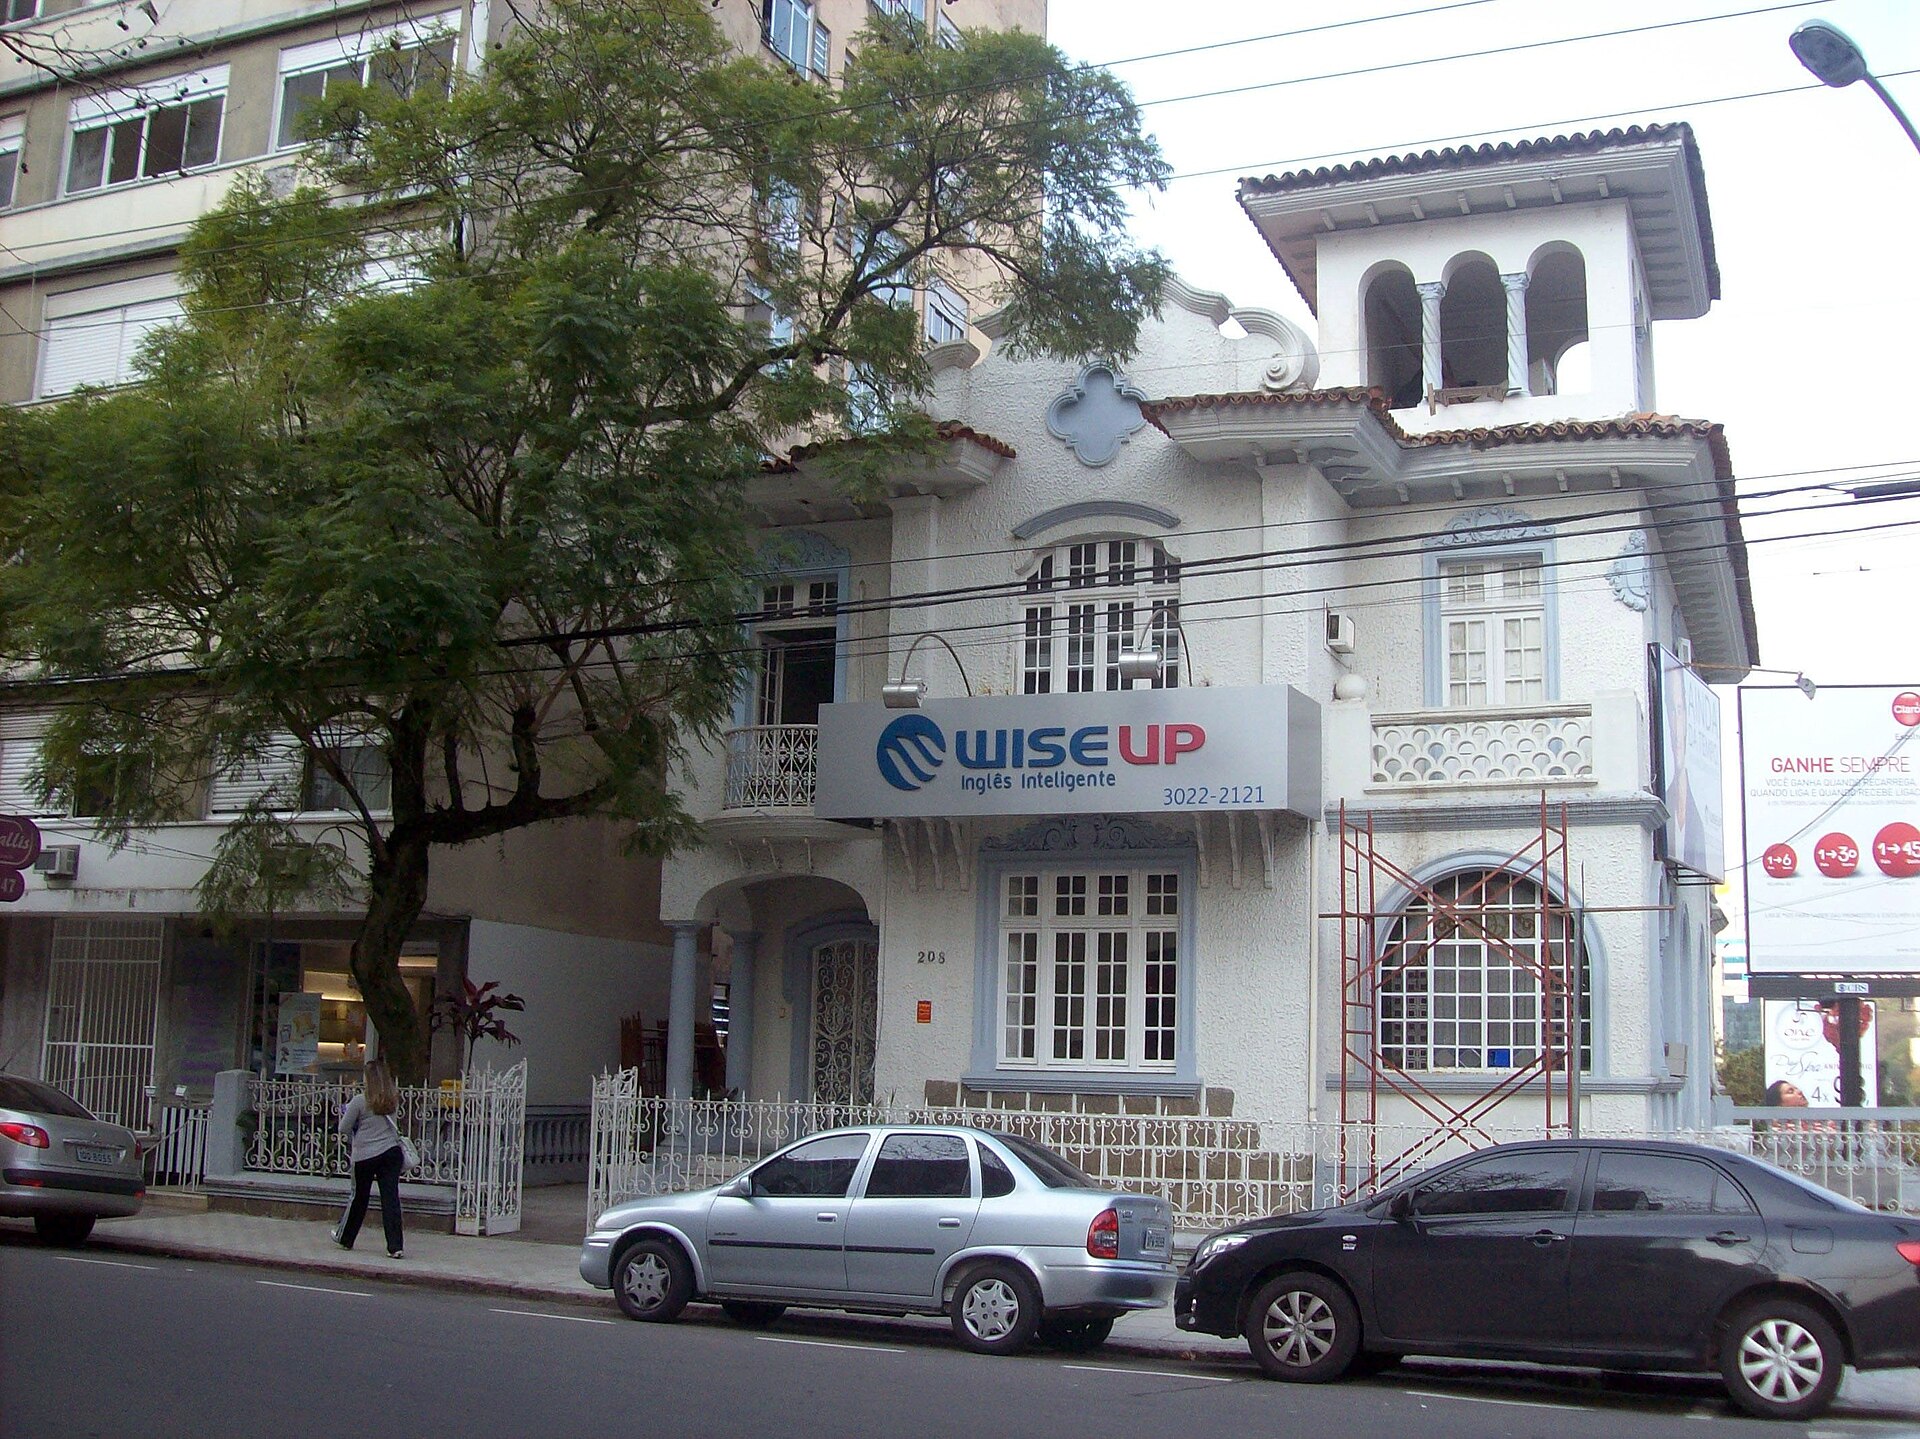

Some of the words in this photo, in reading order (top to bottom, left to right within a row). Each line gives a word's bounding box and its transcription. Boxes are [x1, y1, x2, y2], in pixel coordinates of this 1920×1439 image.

[955, 725, 1109, 769] WISE
[1118, 723, 1206, 765] UP
[1771, 757, 1834, 773] GANHE
[1839, 756, 1911, 773] SEMPRE
[961, 771, 1012, 795] Inglês
[1021, 769, 1116, 793] Inteligente
[1790, 779, 1822, 787] GANHA
[1162, 785, 1265, 807] 3022-2121
[1750, 788, 1788, 797] QUANDO
[917, 950, 946, 964] 208
